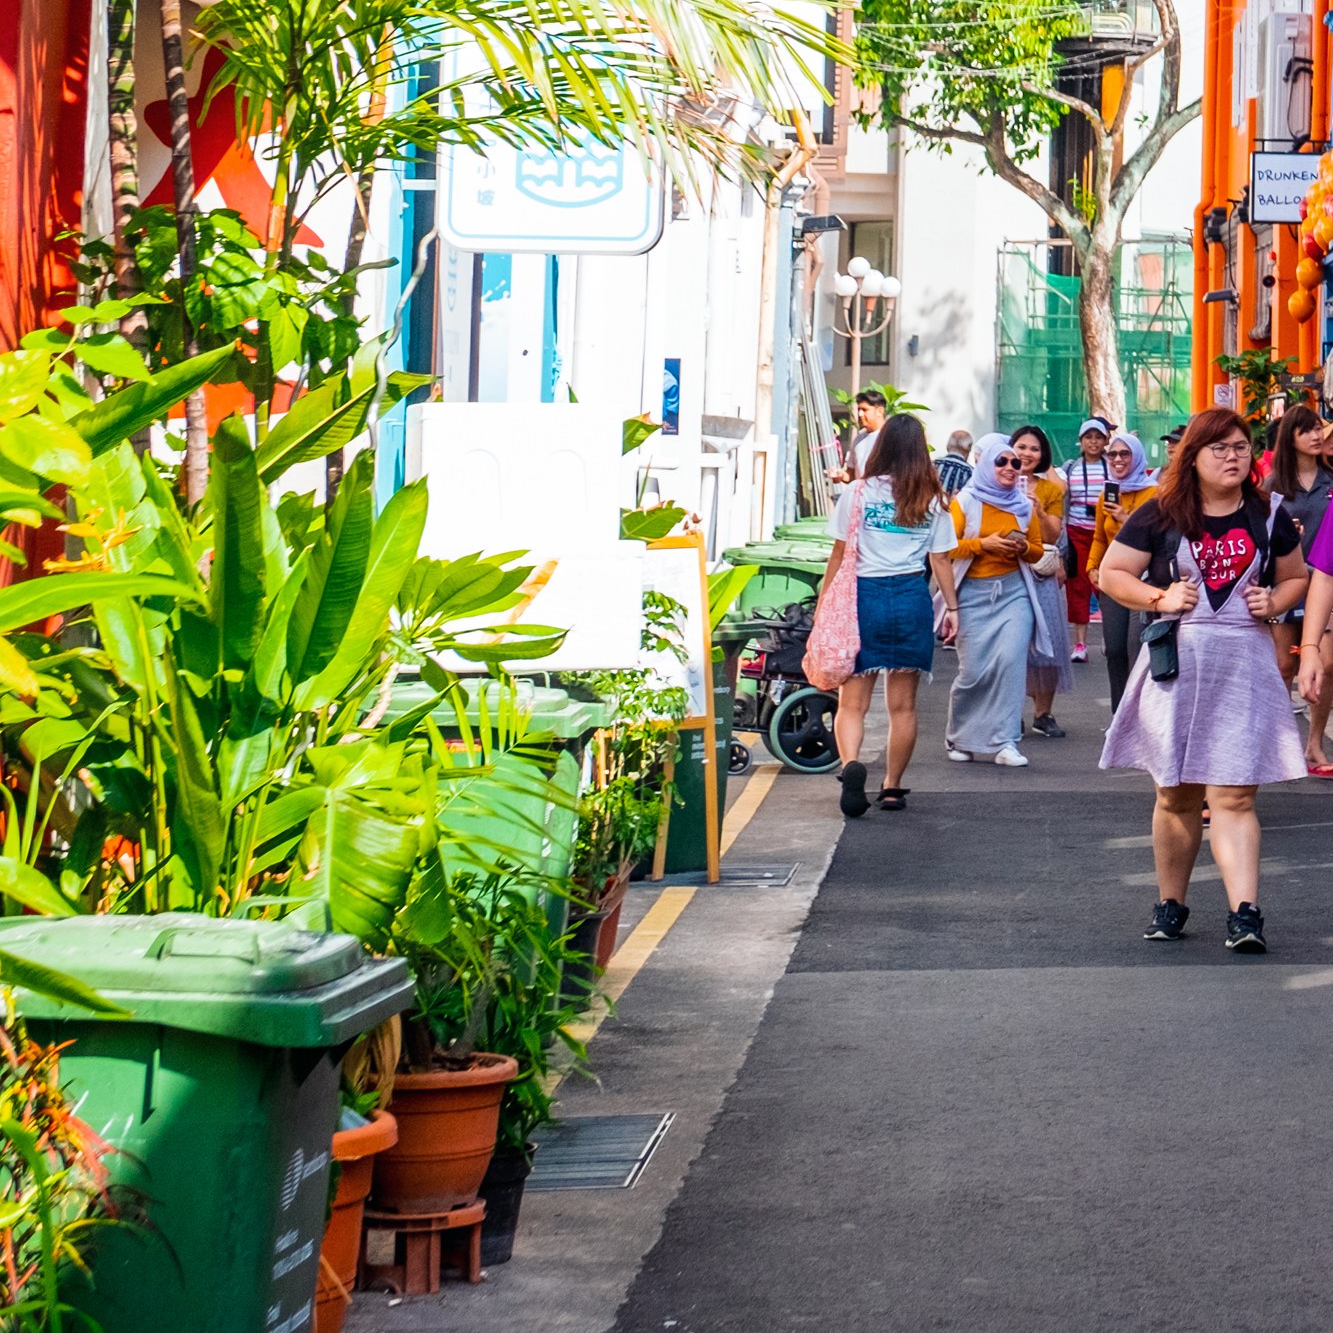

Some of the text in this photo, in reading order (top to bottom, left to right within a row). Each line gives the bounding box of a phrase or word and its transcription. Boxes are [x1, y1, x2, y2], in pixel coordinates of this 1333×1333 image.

[1256, 169, 1319, 182] DRUNKEN
[1257, 194, 1304, 206] BALLO
[1191, 539, 1247, 560] PARIS
